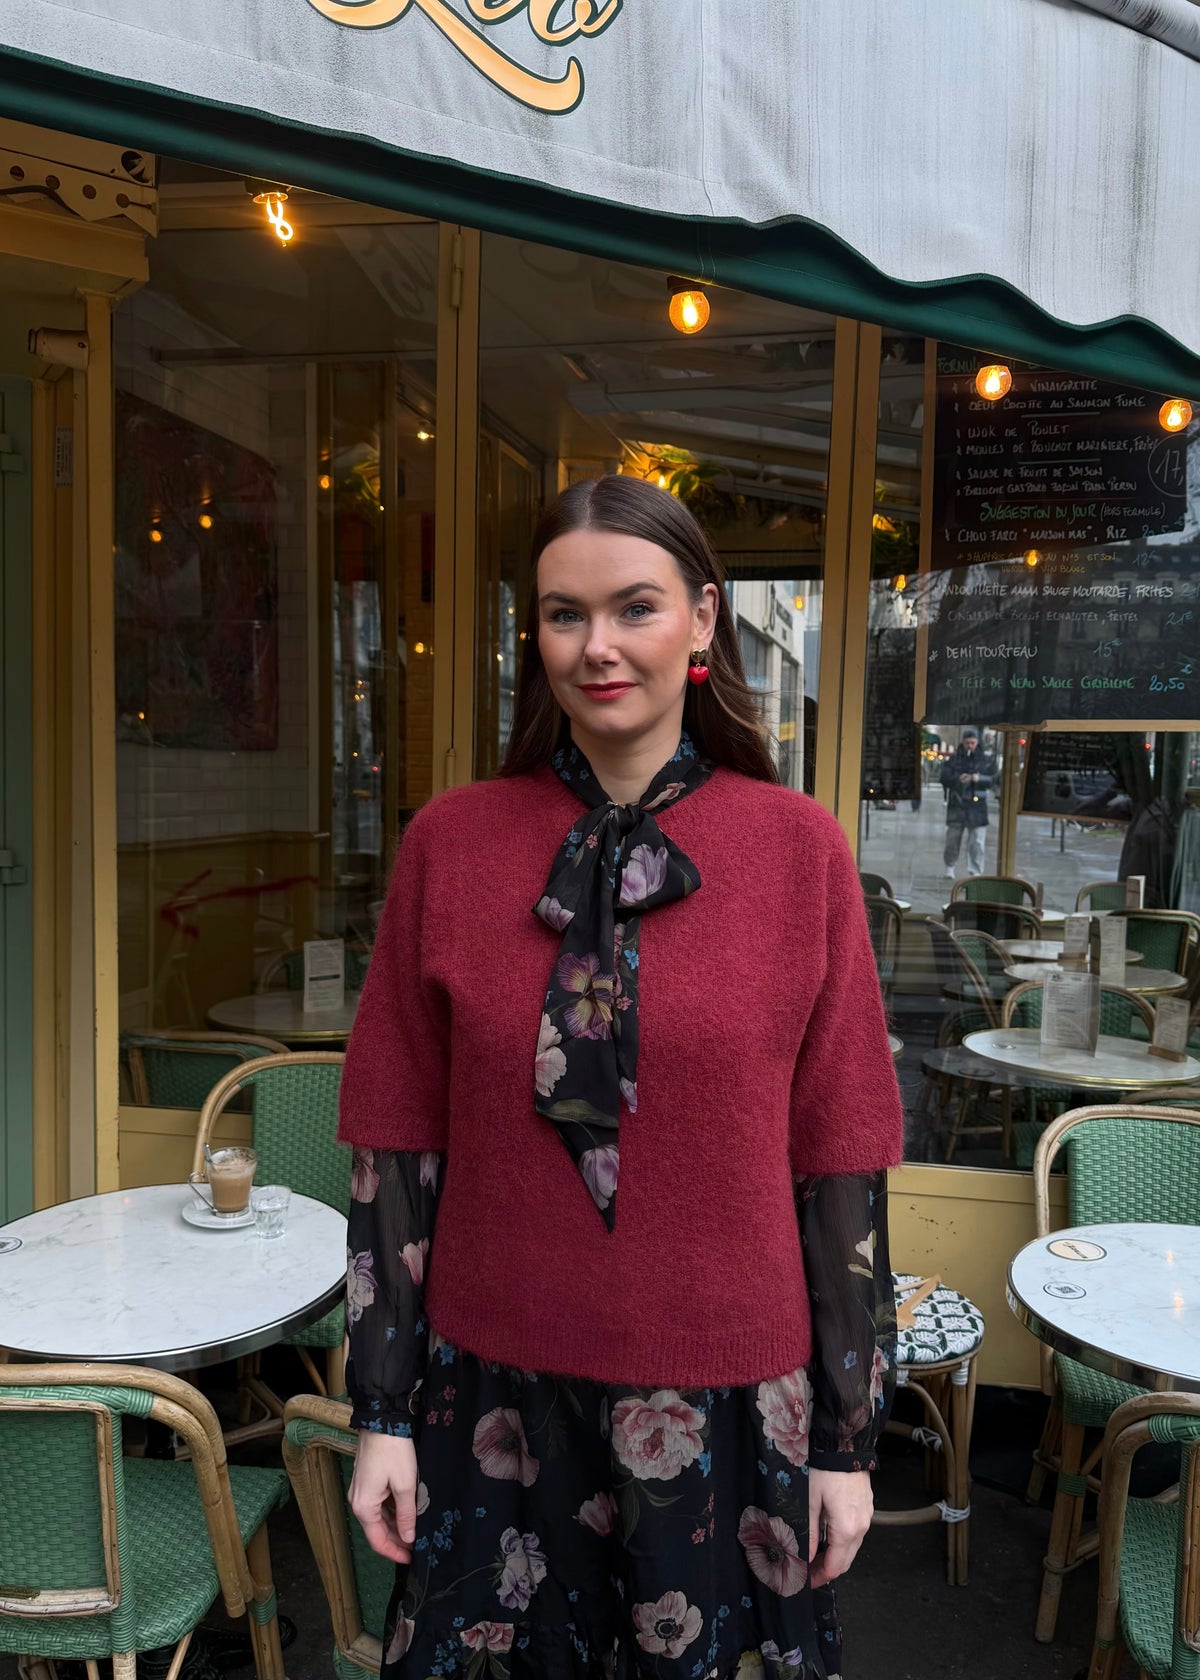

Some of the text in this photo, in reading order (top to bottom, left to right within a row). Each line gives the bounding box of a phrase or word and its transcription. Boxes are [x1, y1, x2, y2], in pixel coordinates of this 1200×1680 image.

[1030, 379, 1098, 393] VINAIGRETTE
[1003, 399, 1042, 410] COCOTTE
[1050, 400, 1063, 409] AU
[1067, 397, 1111, 408] SAUMON
[967, 420, 1070, 438] WOK DE POULET
[965, 443, 1005, 455] MOULES
[1012, 443, 1024, 454] DE
[1030, 440, 1073, 453] BOUCHOT
[967, 464, 1103, 480] SALADE DE FRUITS DE SAISON
[963, 484, 1005, 497] BRIOCHE
[1081, 480, 1106, 493] PAIN
[1055, 505, 1067, 520] DU
[1066, 503, 1098, 526] JOUR
[957, 528, 988, 543] CHOU
[989, 529, 1018, 541] FARCI
[1106, 525, 1128, 539] RIZ
[1042, 585, 1070, 597] SAUCE
[975, 643, 1038, 660] TOURTEAU
[1009, 672, 1037, 689] VEAU
[1042, 675, 1075, 689] SAUCE
[1080, 675, 1137, 690] GRIBICHE
